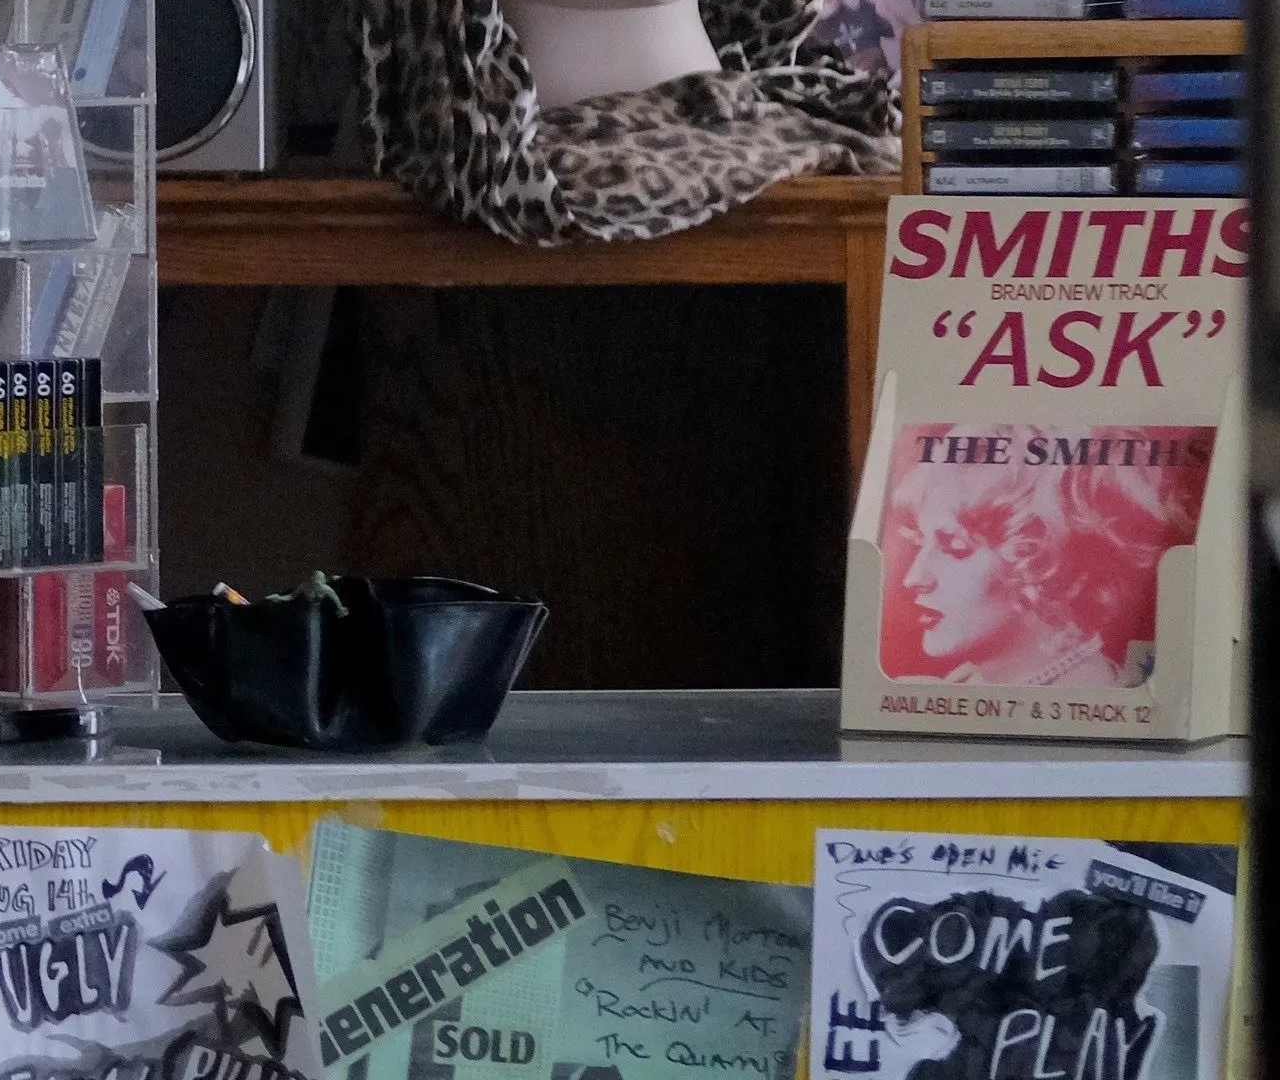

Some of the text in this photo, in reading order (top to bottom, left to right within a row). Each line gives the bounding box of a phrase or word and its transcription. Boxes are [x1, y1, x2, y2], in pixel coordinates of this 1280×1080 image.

[889, 208, 1250, 280] SMITHS
[991, 284, 1169, 301] BRAND NEW TRACK
[13, 372, 28, 398] 60
[36, 372, 52, 398] 60
[60, 370, 76, 396] 60
[917, 435, 1213, 468] THE SMITHS
[106, 605, 123, 670] TDK
[880, 694, 968, 717] AVAILABLE
[975, 699, 1001, 717] ON
[1032, 702, 1044, 719] &
[1051, 702, 1061, 719] 3
[1069, 702, 1125, 723] TRACK
[932, 845, 996, 873] OPEN
[1092, 868, 1148, 899] you'll
[1147, 880, 1185, 910] like
[59, 908, 112, 936] extra
[874, 904, 1075, 981] COME
[1, 923, 132, 1025] UGLY
[436, 1023, 536, 1066] SOLD
[594, 1032, 651, 1060] The
[990, 1008, 1144, 1080] PLAY
